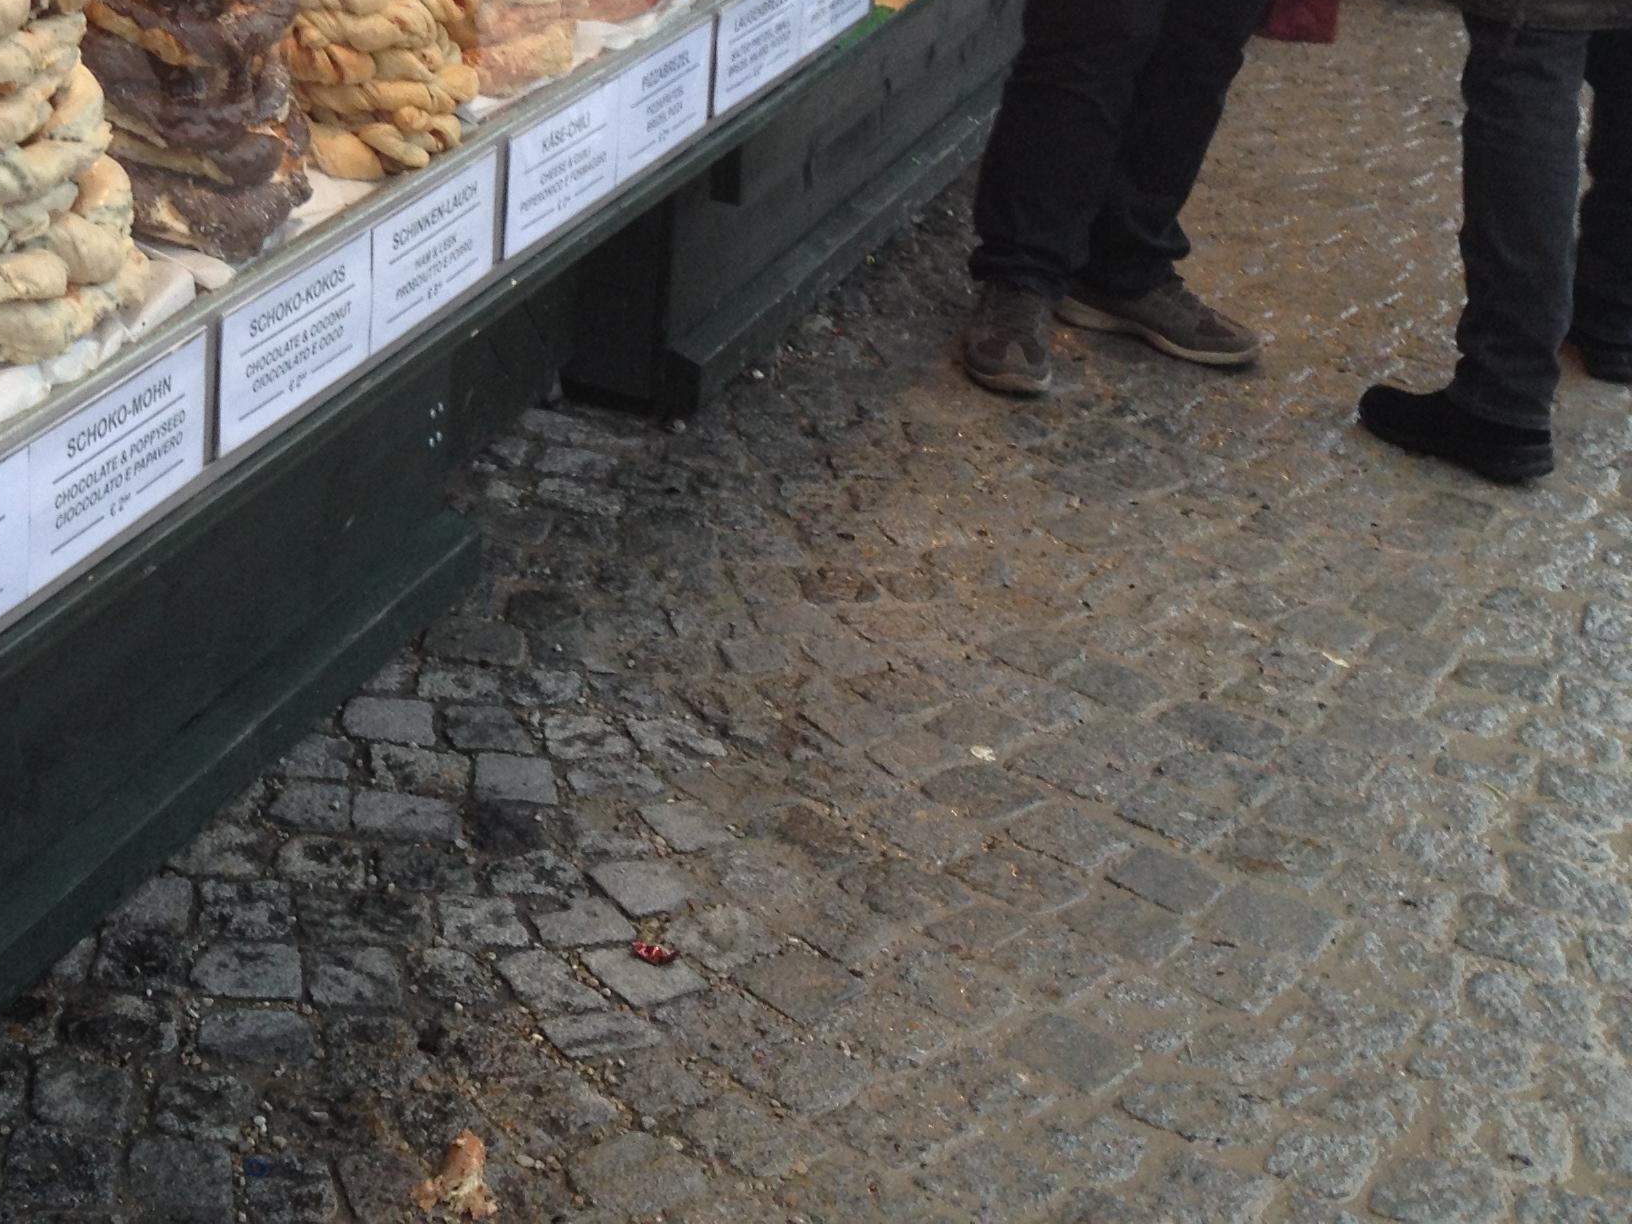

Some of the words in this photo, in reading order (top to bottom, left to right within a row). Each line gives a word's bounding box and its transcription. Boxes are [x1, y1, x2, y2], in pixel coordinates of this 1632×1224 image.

[245, 336, 301, 379] CHOCOLATE
[310, 301, 352, 337] COCONUT
[250, 264, 346, 338] SCHOKO-KOKOS
[252, 346, 311, 393] CIOCCOLATO
[319, 325, 344, 352] COCO
[67, 376, 172, 459] SCHOKO-MOHN
[55, 456, 118, 510] CHOCOLATE
[120, 450, 128, 464] &
[129, 409, 186, 458] POPPYSEED
[55, 473, 123, 530] CIOCCOLATO
[133, 431, 184, 476] PAPAVERO
